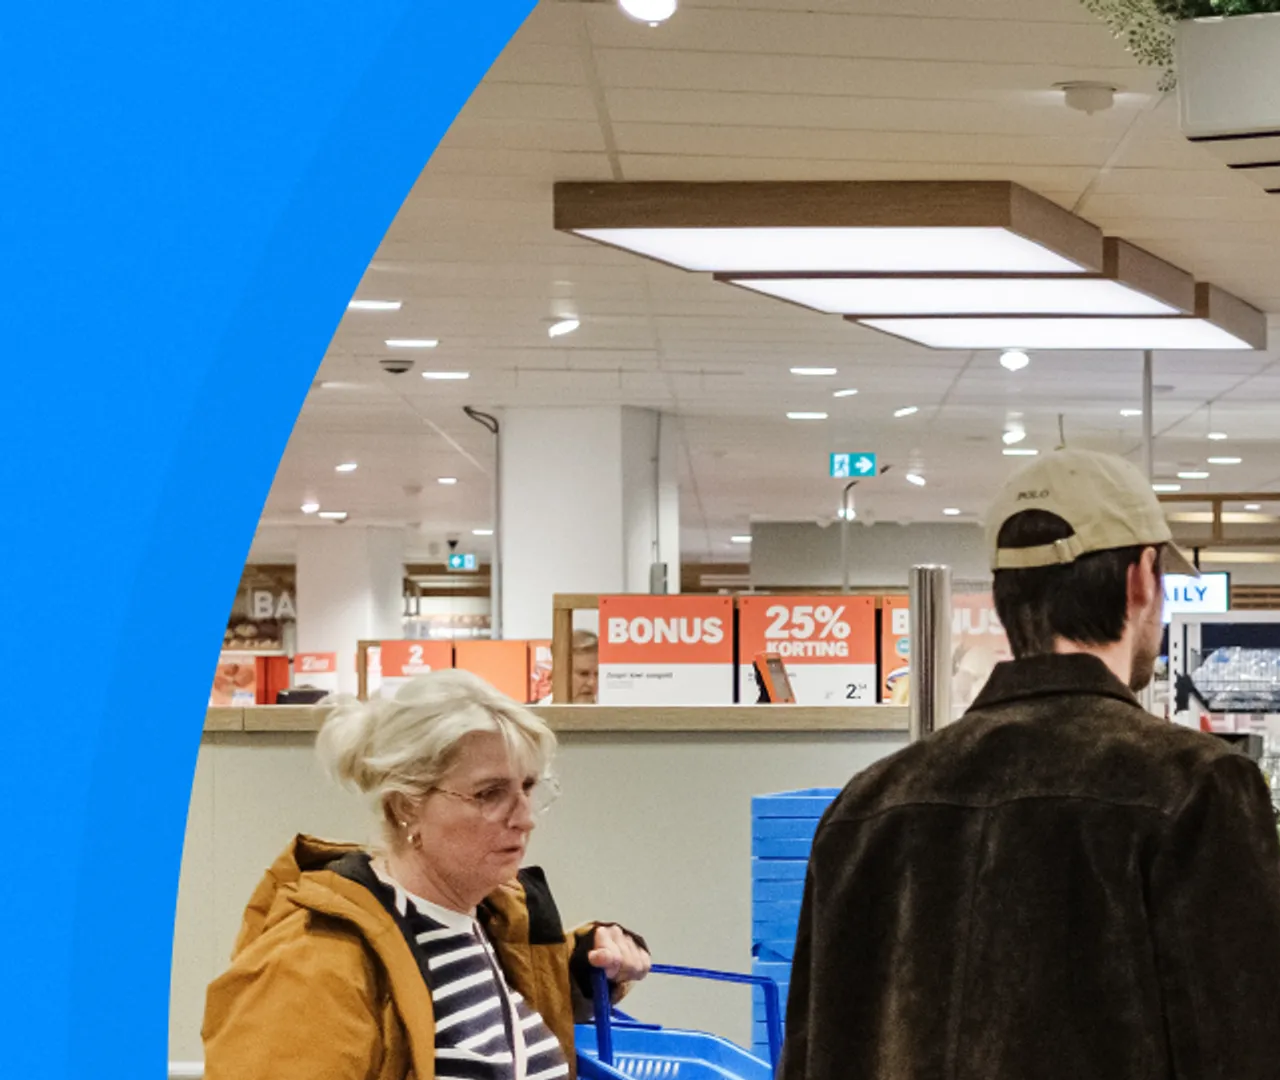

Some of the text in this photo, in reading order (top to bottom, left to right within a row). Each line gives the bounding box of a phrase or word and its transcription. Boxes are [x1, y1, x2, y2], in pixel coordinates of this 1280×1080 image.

[1017, 490, 1049, 501] POLO
[607, 617, 723, 645] BONUS
[764, 604, 851, 639] 25%
[766, 641, 849, 657] KORTING
